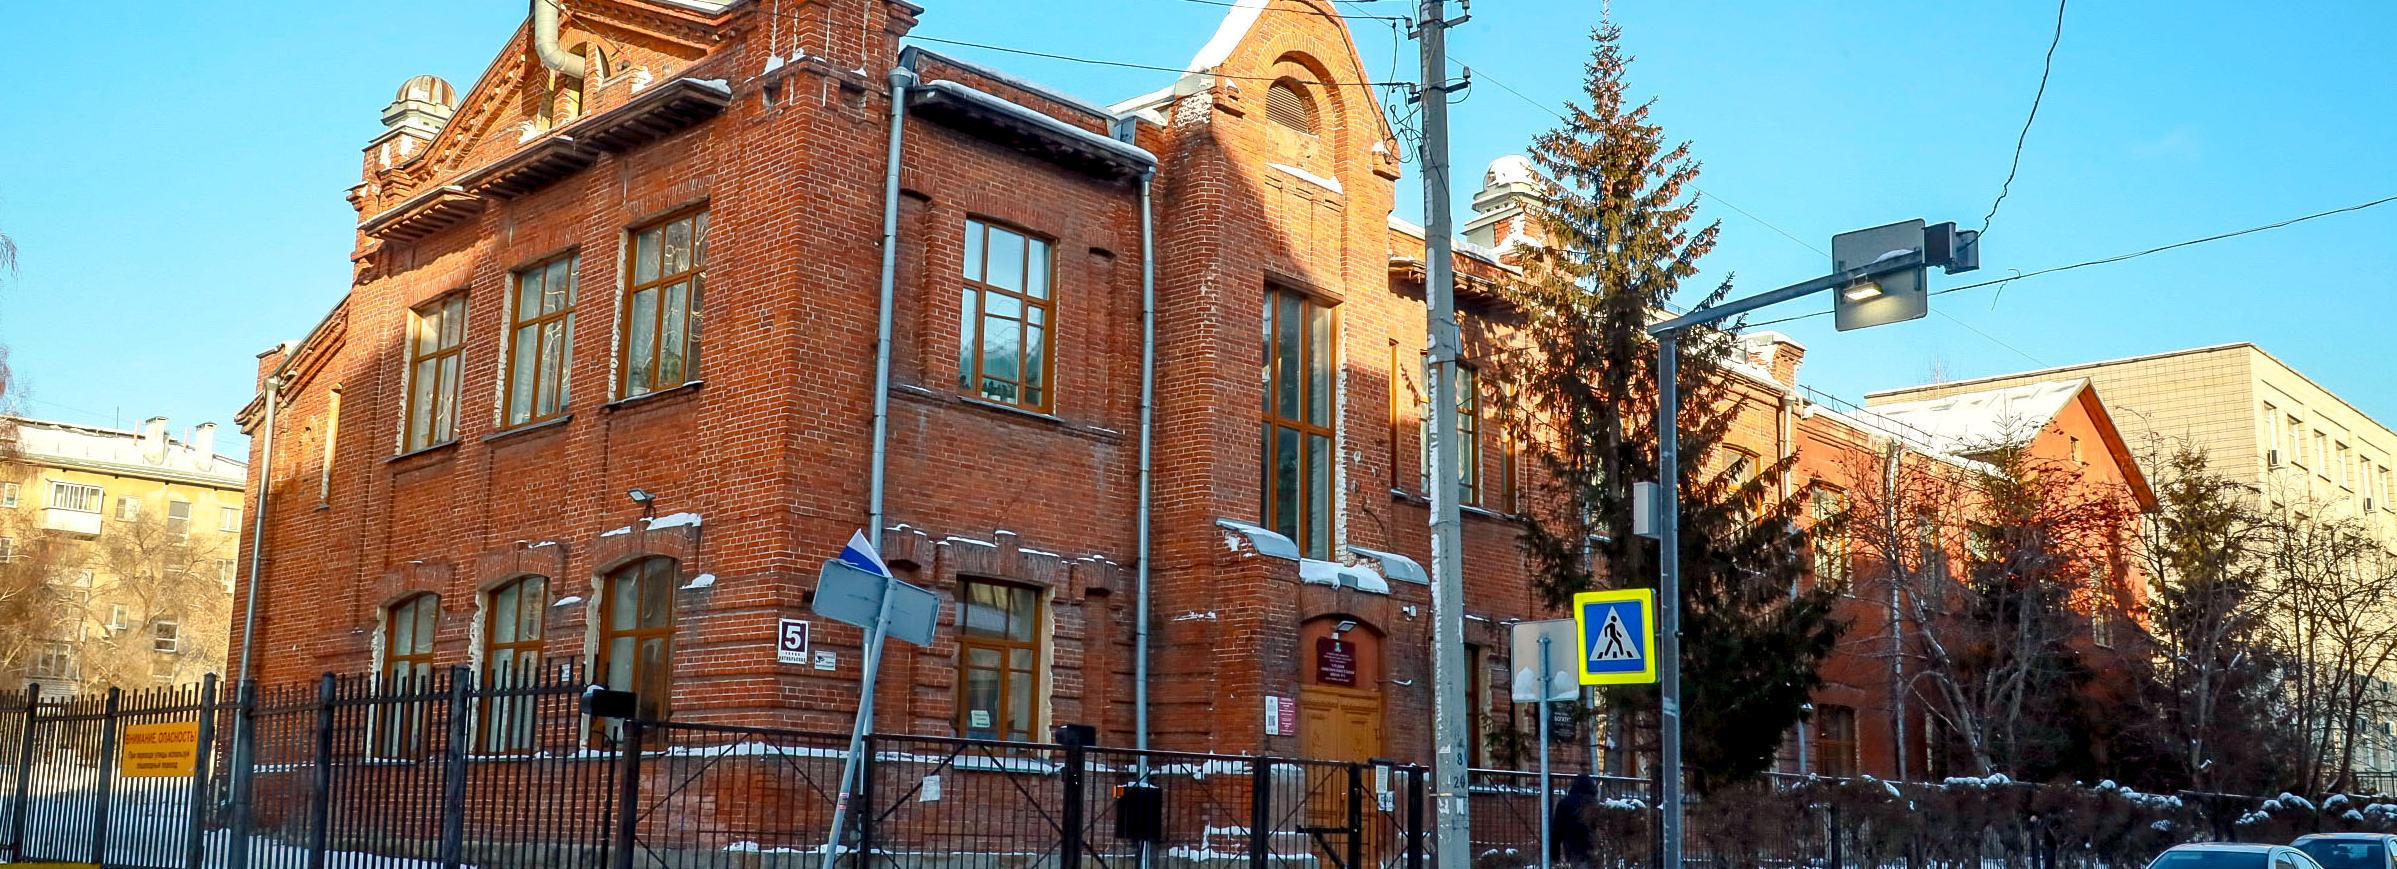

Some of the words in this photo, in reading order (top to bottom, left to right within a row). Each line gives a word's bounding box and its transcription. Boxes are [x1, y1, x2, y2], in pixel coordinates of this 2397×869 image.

[785, 625, 801, 649] 5
[1457, 753, 1463, 765] 8
[1454, 776, 1466, 789] 20
